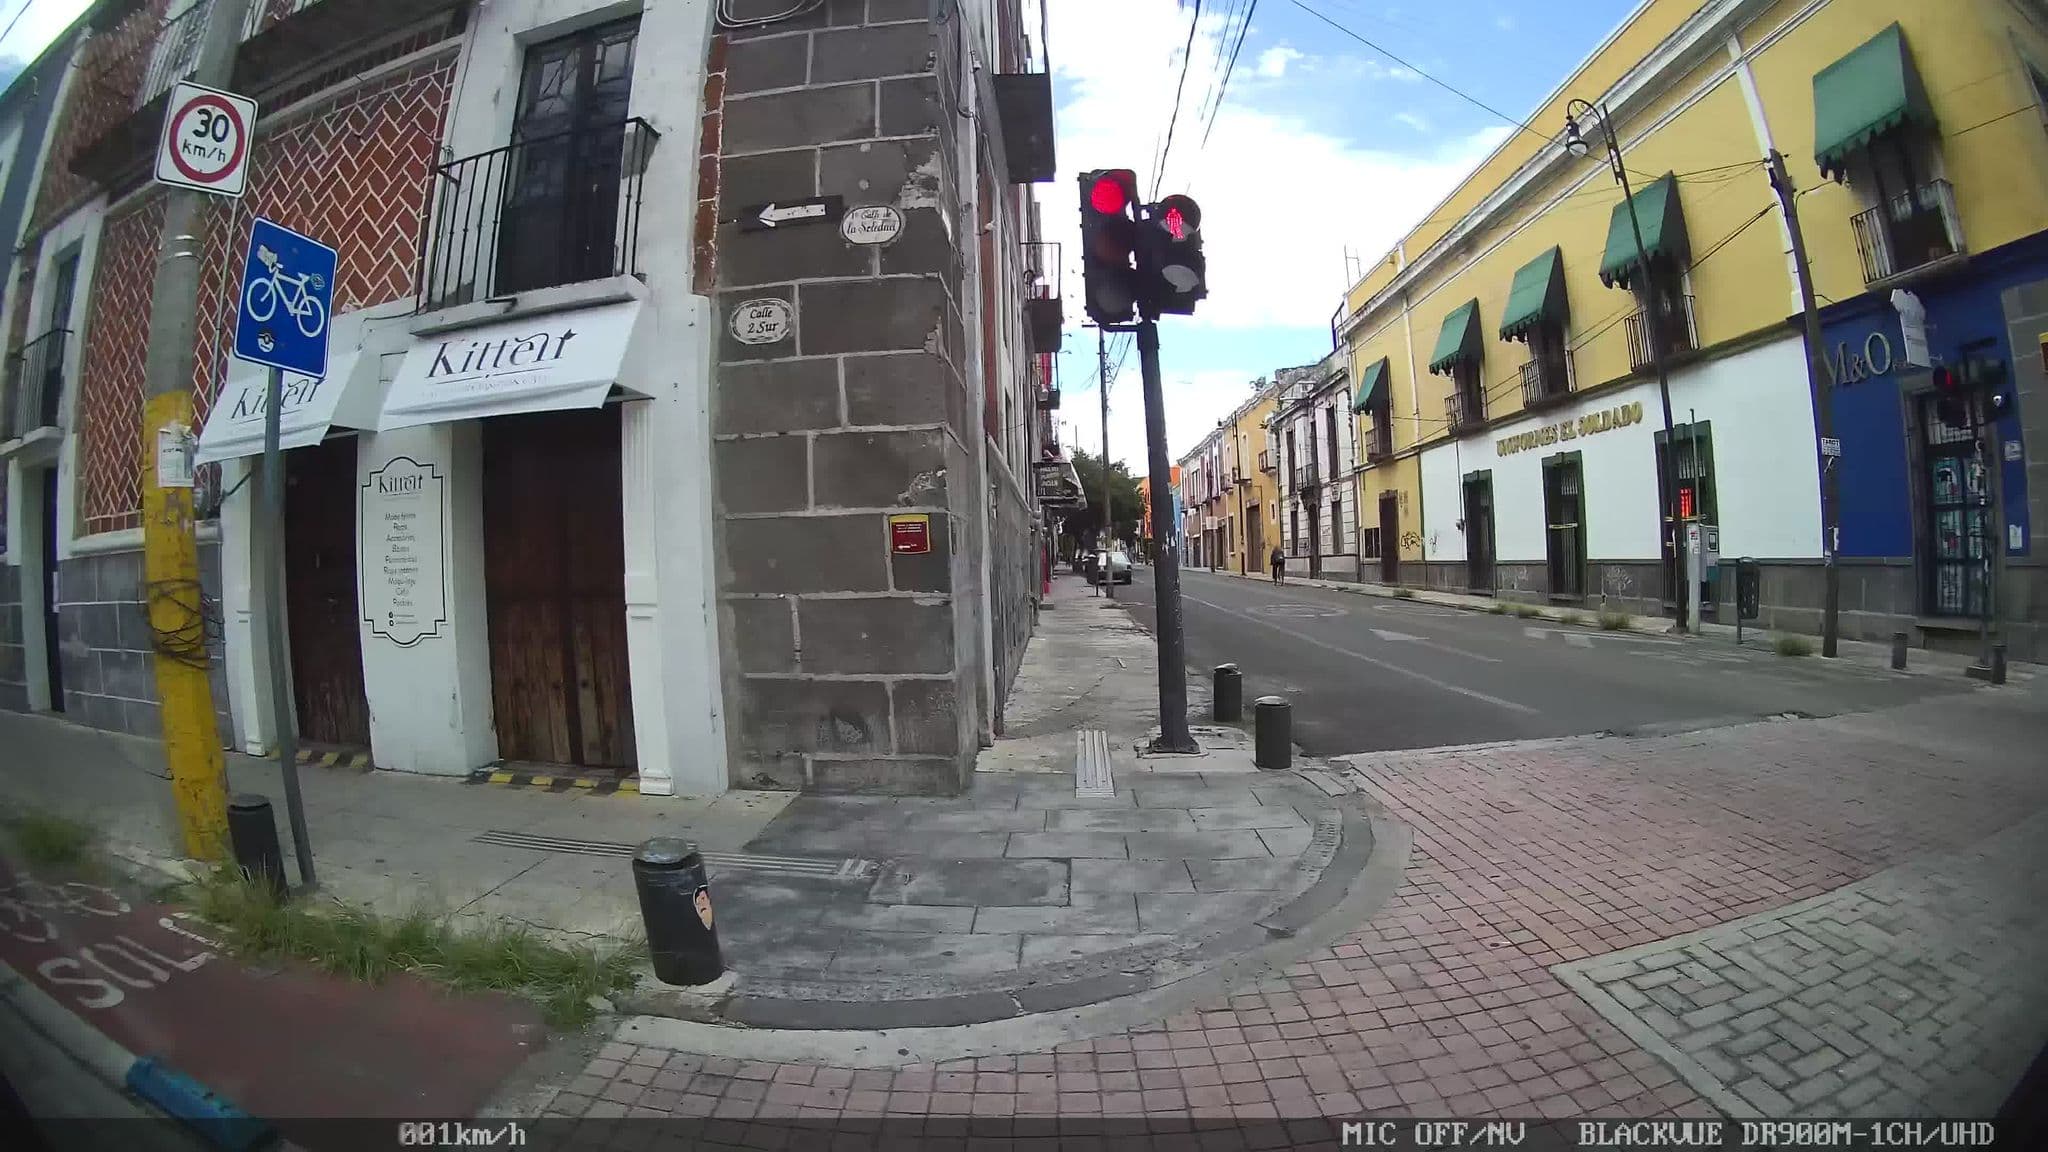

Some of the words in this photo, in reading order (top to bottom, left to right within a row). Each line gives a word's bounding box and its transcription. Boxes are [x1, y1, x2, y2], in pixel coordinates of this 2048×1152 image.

[192, 108, 230, 143] 30
[182, 139, 226, 162] km/h
[750, 307, 773, 319] Calle
[747, 322, 756, 334] 2
[756, 320, 779, 334] Sur
[1559, 419, 1577, 442] EL
[1577, 401, 1644, 438] SOLDADO
